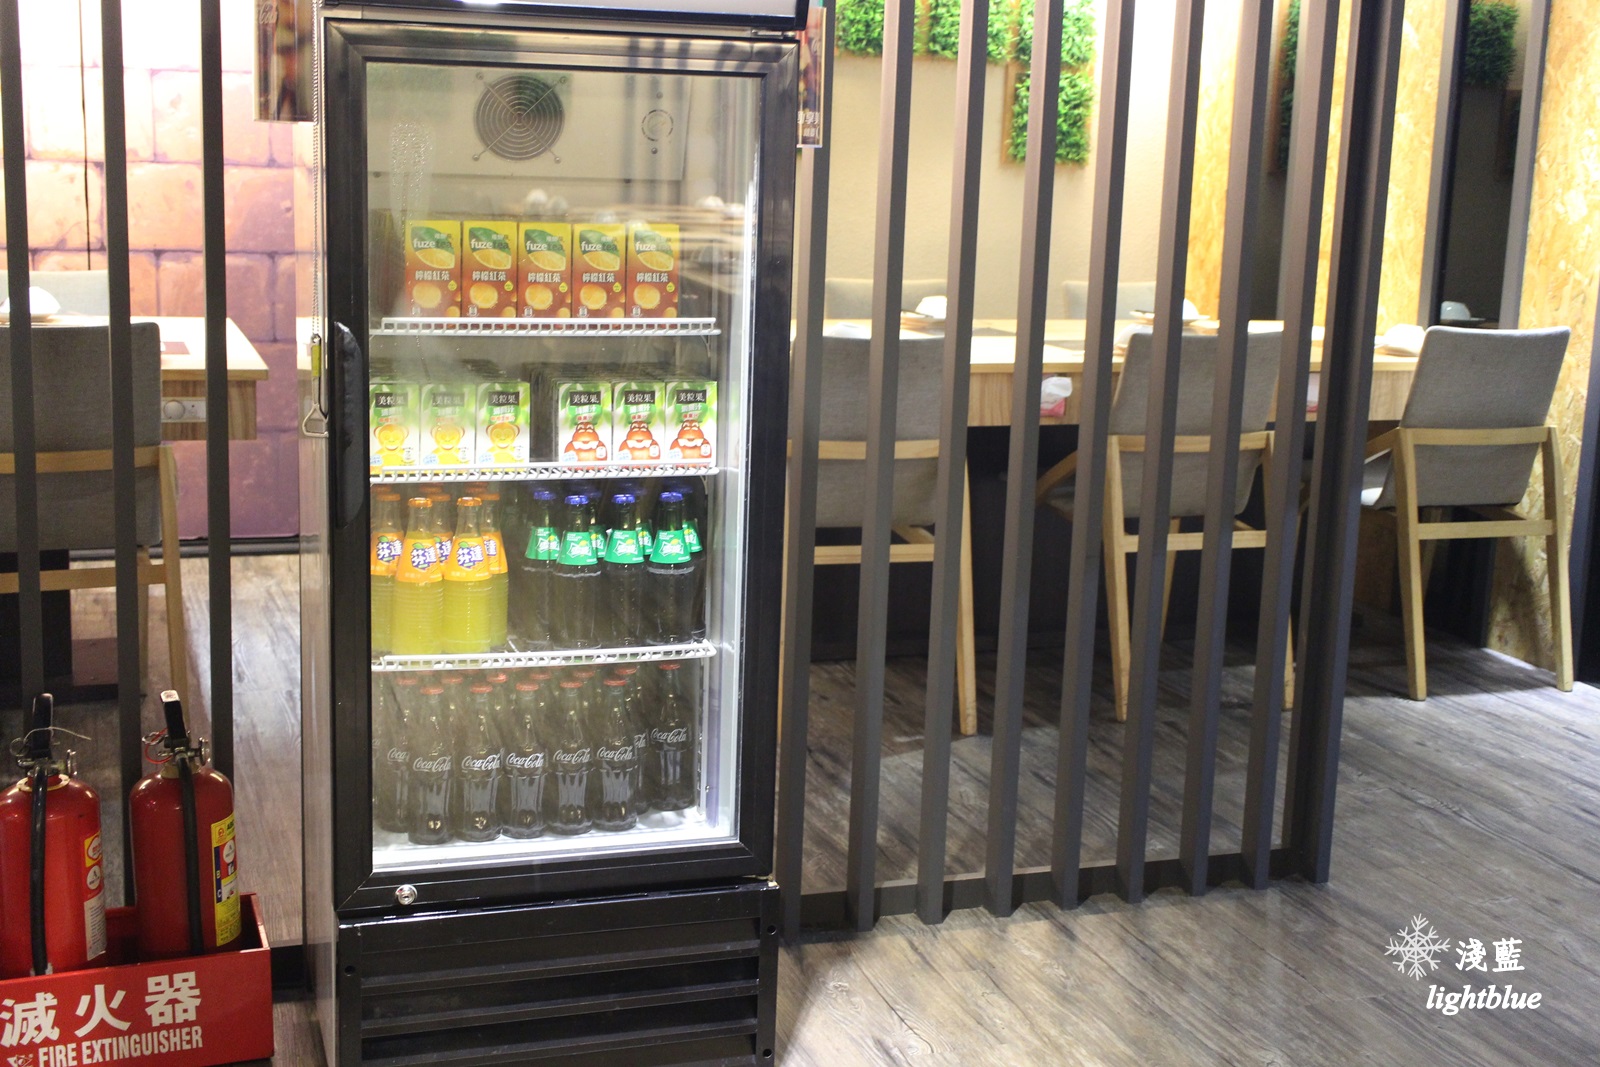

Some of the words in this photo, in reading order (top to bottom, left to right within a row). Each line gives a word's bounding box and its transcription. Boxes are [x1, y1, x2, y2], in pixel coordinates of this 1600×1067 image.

[415, 270, 450, 281] 檸檬紅茶
[472, 271, 507, 281] 檸檬紅茶
[527, 272, 561, 283] 檸檬紅茶
[582, 272, 615, 283] 檸檬紅茶
[636, 272, 669, 283] 檸檬紅茶
[572, 393, 598, 404] 美粒果
[627, 393, 653, 404] 美粒果
[678, 392, 703, 403] 美粒果
[376, 540, 402, 561] 芬達
[410, 546, 437, 566] 芬達
[456, 545, 483, 566] 芬達
[650, 727, 687, 744] Coca-Cola
[461, 753, 501, 771] Coca-Cola
[506, 751, 545, 769] Coca-Cola
[553, 747, 591, 765] Coca-Cola
[597, 746, 633, 762] Coca-Cola
[412, 756, 452, 773] Coca-Cola
[0, 971, 202, 1048] 滅火器
[38, 1042, 78, 1067] FIRE
[81, 1025, 203, 1065] EXTINGUISHER
